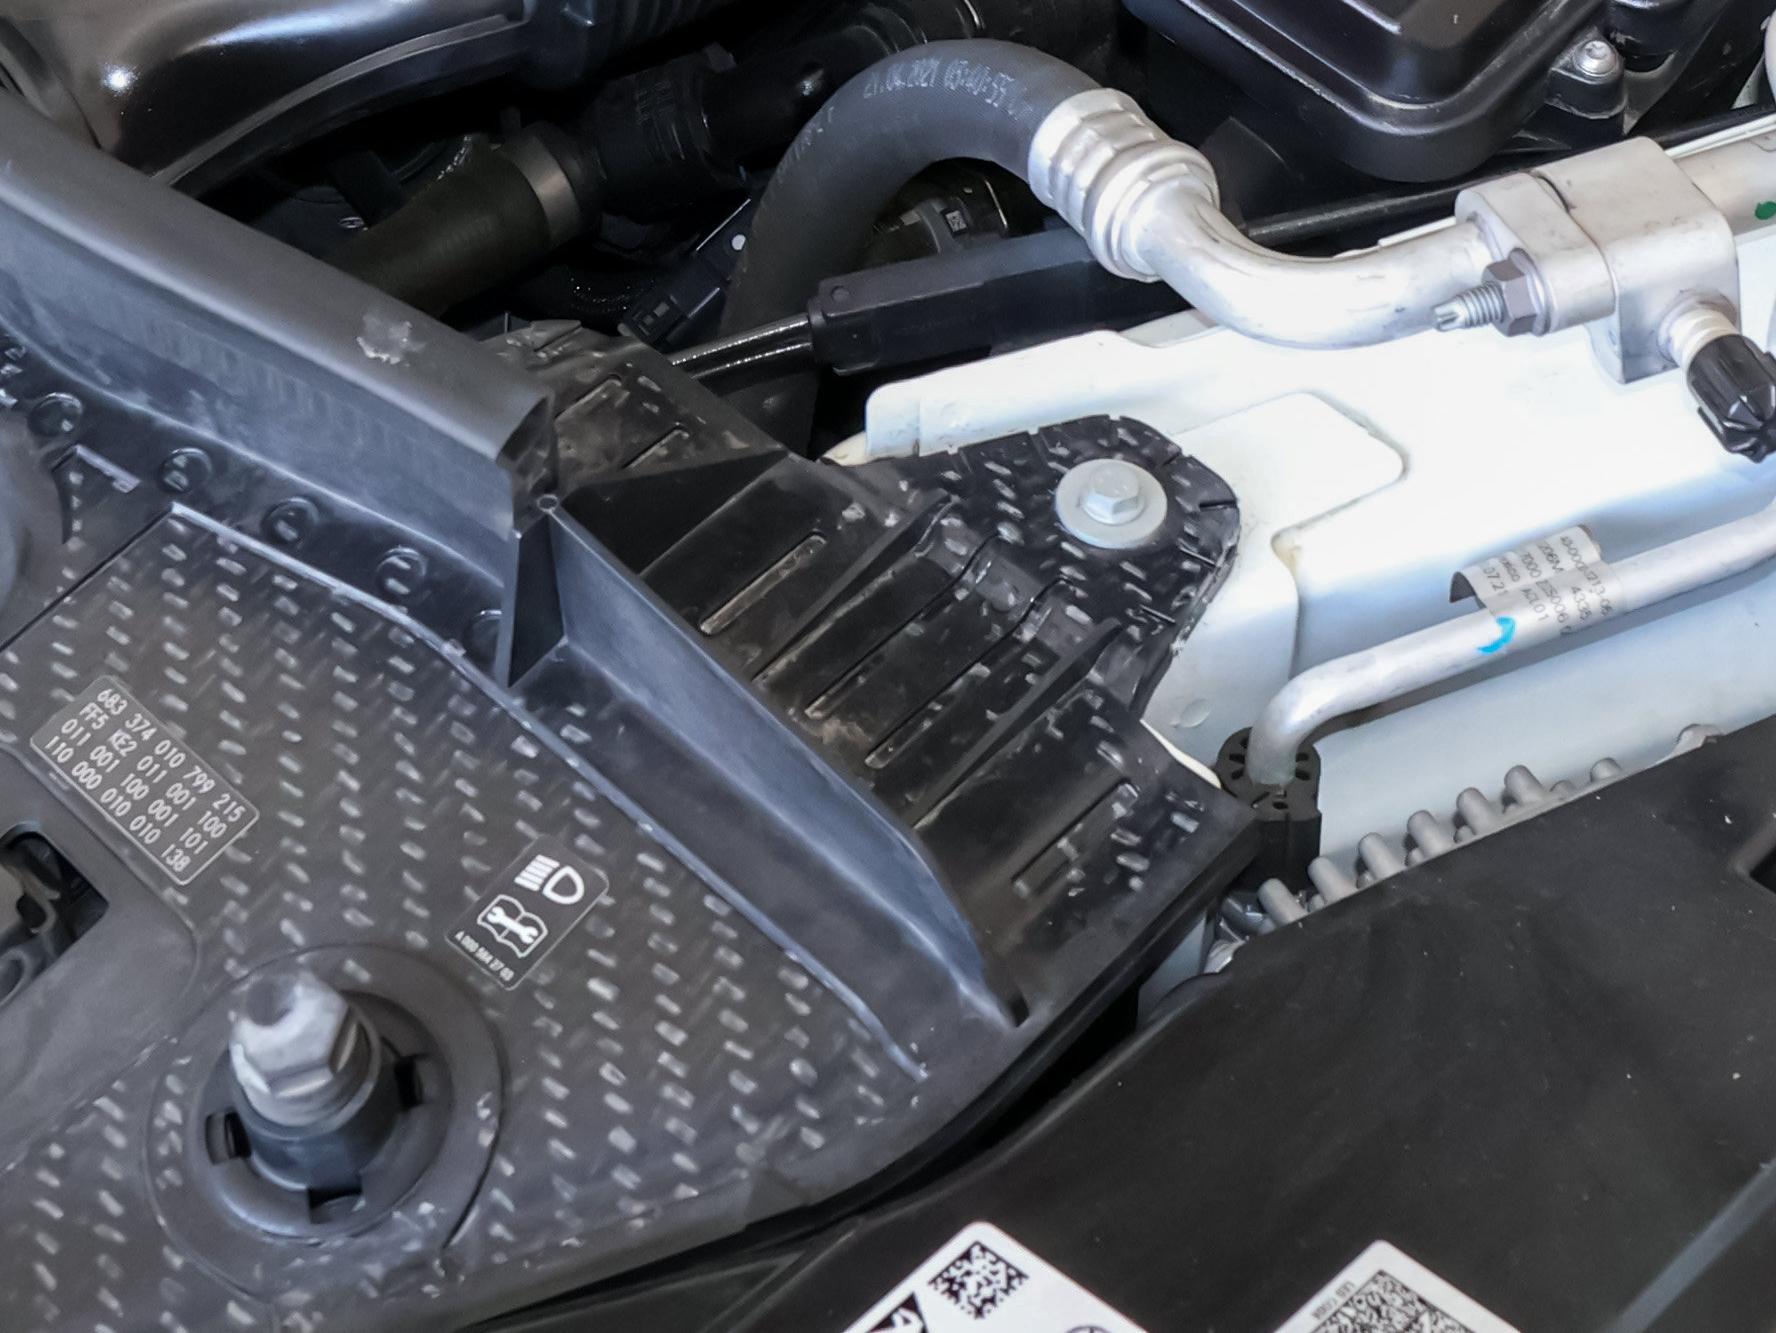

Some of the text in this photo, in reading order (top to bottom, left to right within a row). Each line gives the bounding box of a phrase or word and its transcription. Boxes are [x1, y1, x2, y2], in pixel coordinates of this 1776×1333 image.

[44, 735, 192, 873] 110 000 010 010 138
[61, 718, 208, 855] 011 001 100 001 101
[79, 702, 228, 839] FF5 KE2 011 001 100
[97, 688, 246, 822] 683 374 010 799 215
